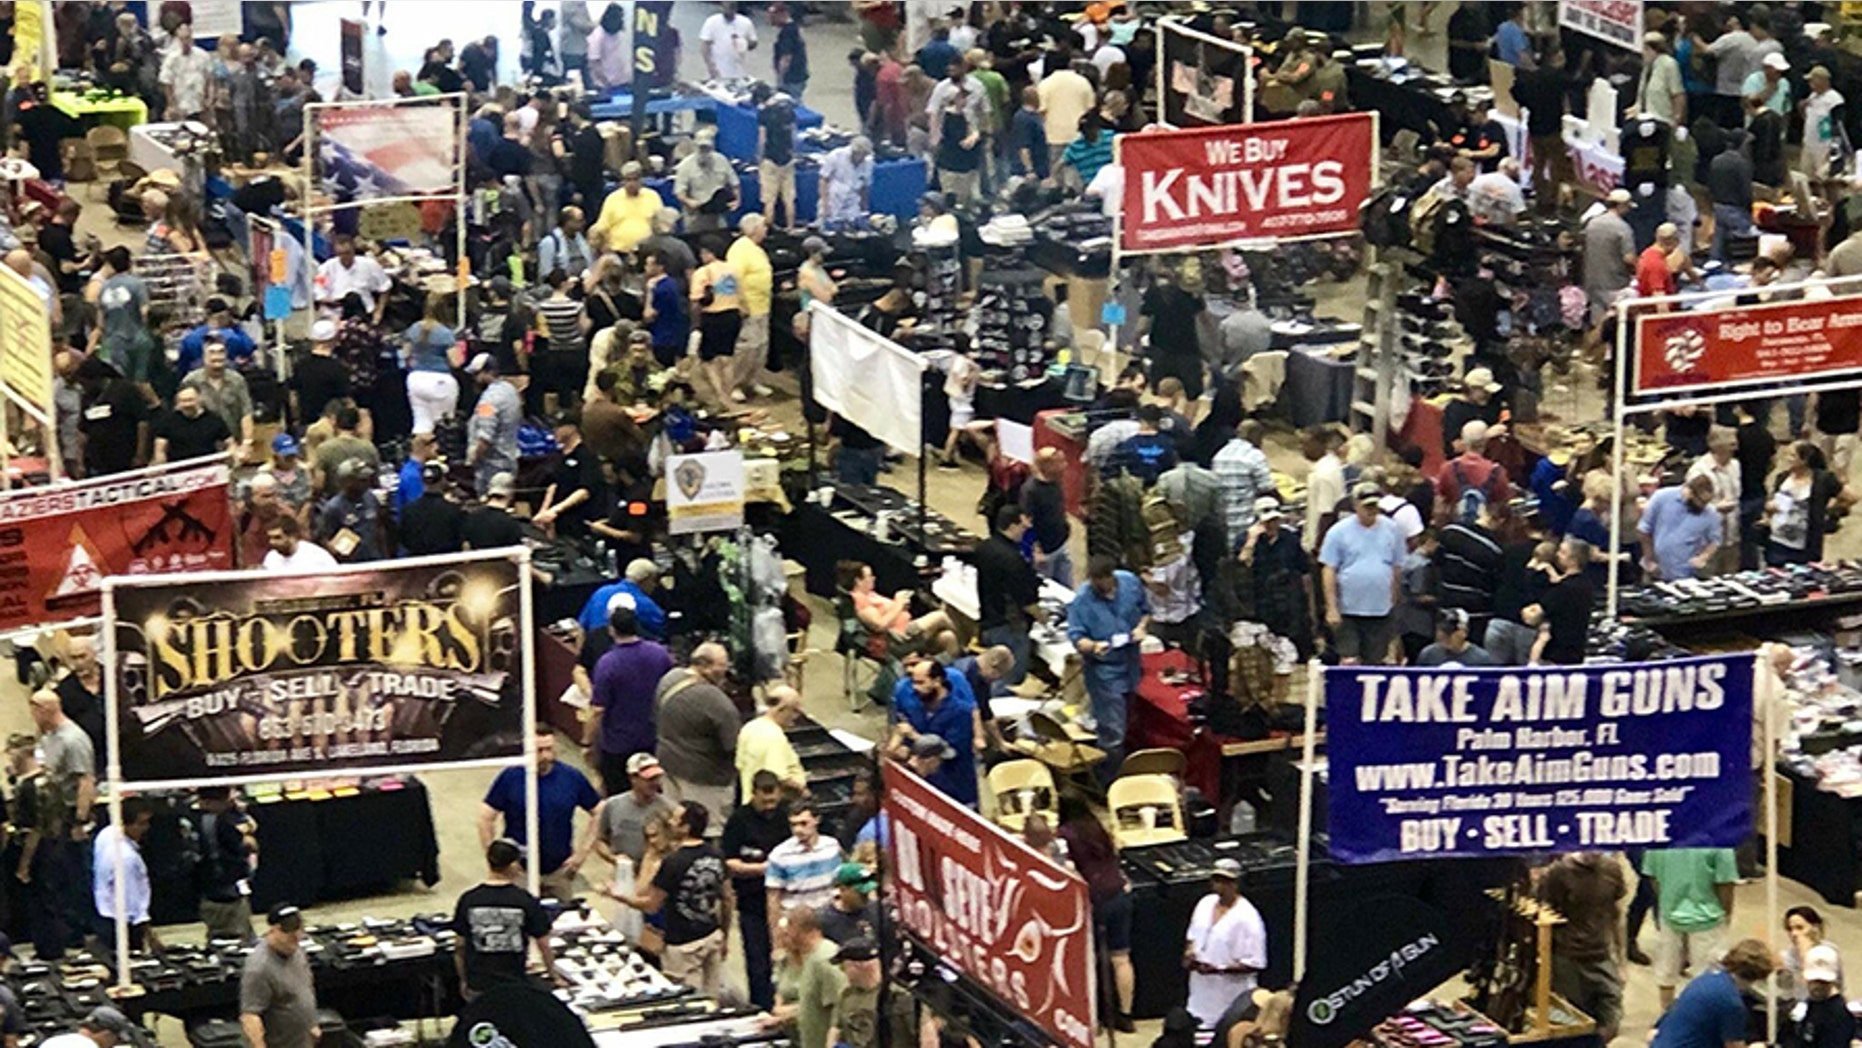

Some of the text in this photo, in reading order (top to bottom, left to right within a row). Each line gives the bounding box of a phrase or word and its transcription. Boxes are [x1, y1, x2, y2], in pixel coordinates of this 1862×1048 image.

[1244, 137, 1290, 163] BUY
[1141, 159, 1346, 224] KNIVES
[1718, 323, 1761, 342] Right
[1763, 319, 1784, 335] to
[1786, 316, 1826, 334] Bear
[154, 601, 482, 701] SHOOTERS
[185, 671, 457, 719] BUY SELL TRADE
[1356, 663, 1727, 723] TAKE AIM GUNS
[1456, 728, 1512, 751] Palm
[1596, 722, 1620, 746] FL
[1354, 750, 1721, 792] www.TakeAimGuns.com
[1400, 809, 1673, 853] BUY SELL TRADE
[1401, 931, 1440, 963] GUN
